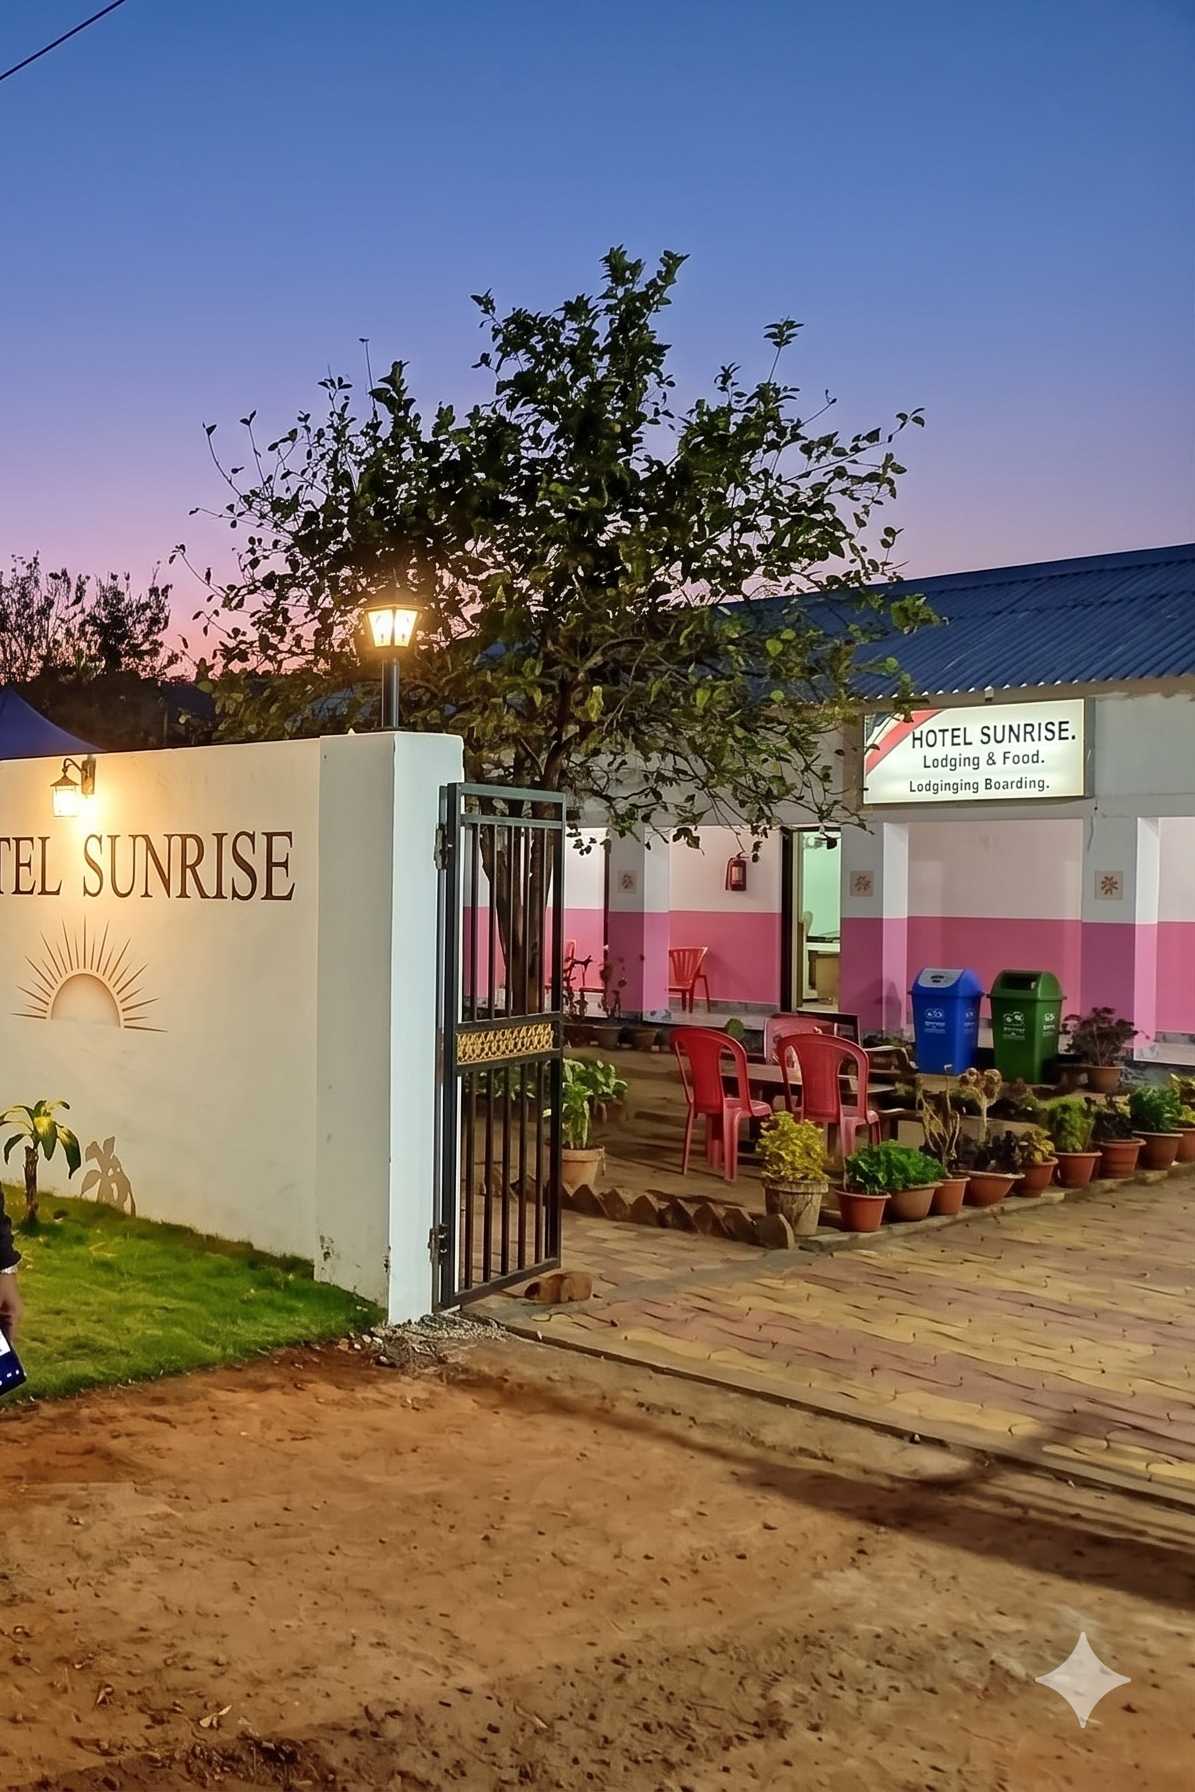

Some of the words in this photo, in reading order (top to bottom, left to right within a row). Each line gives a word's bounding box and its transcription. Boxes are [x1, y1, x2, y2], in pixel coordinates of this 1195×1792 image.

[911, 726, 973, 749] HOTEL
[980, 720, 1076, 745] SUNRISE.
[923, 752, 980, 772] Lodging
[986, 751, 997, 766] &
[1003, 749, 1045, 766] Food.
[909, 779, 979, 794] Lodginging
[984, 776, 1050, 792] Boarding.
[82, 830, 296, 901] SUNRISE
